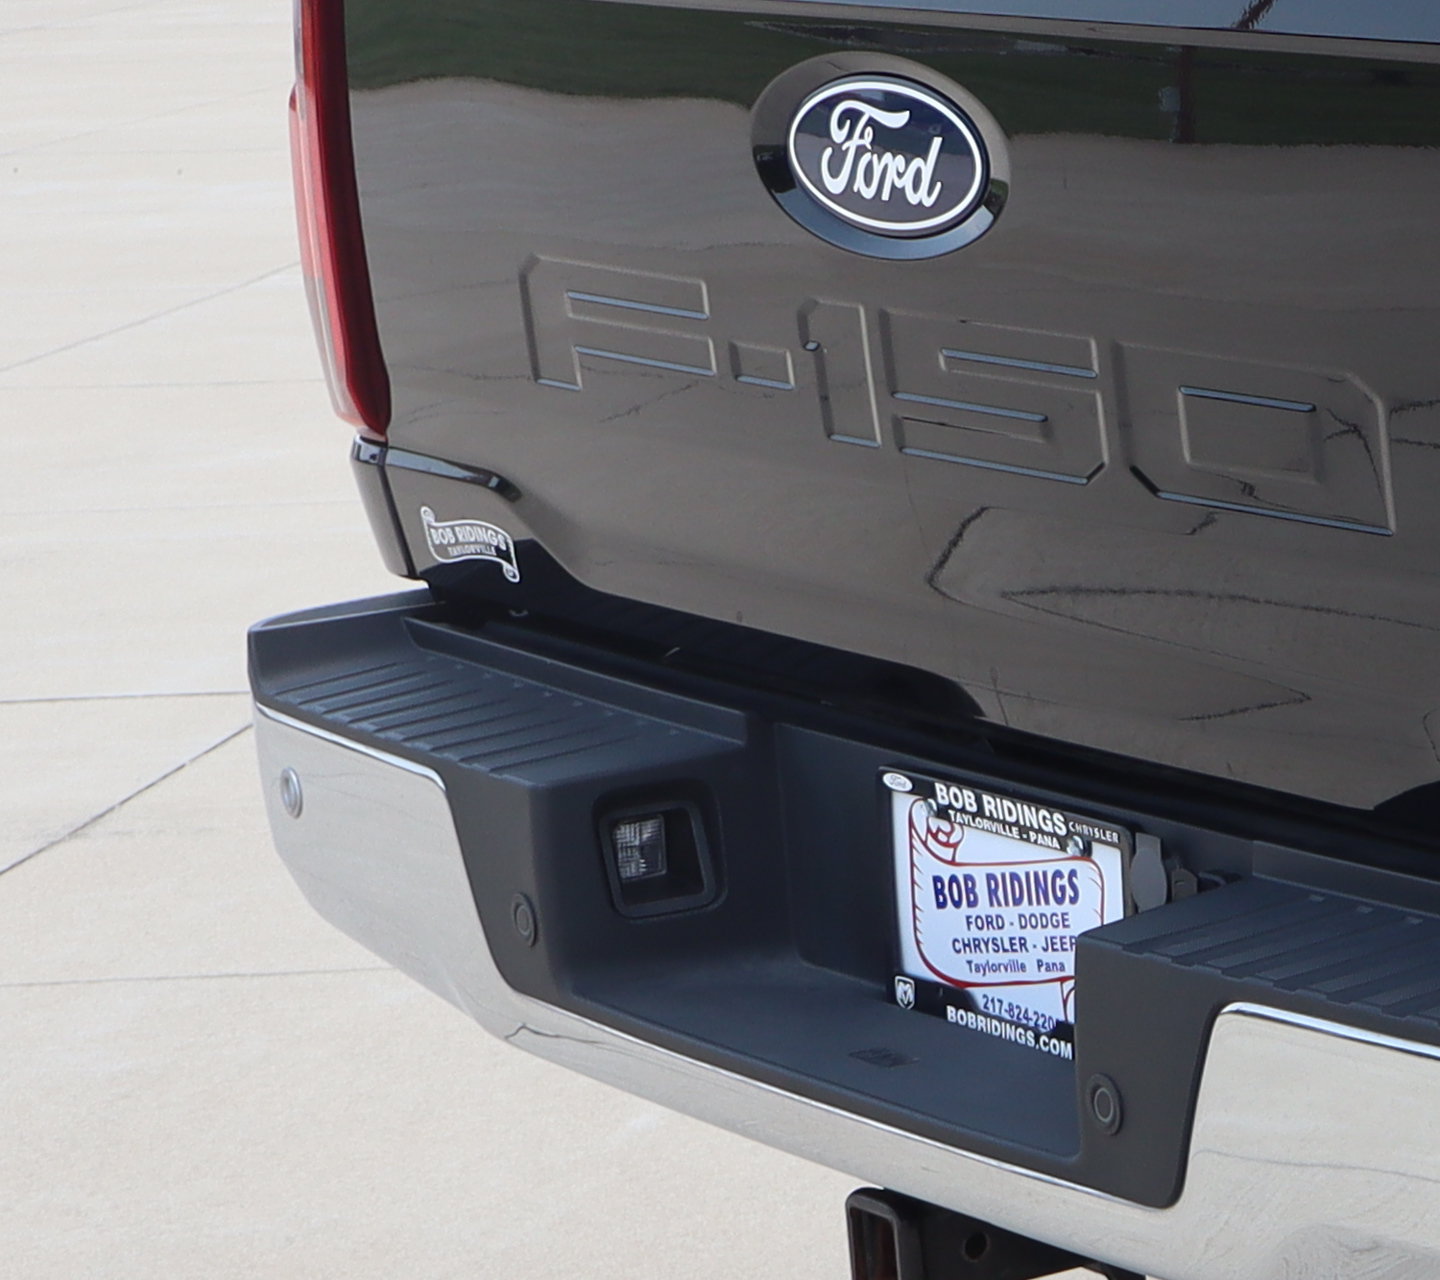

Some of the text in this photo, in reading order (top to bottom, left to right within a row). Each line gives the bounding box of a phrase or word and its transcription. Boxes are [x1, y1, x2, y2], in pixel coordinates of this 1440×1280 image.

[820, 98, 942, 208] Ford
[518, 253, 1394, 538] F-150
[430, 525, 507, 551] BOB RIDINGS
[934, 781, 979, 814] BOB
[981, 793, 1068, 837] RIDINGS
[948, 809, 1021, 840] TAYLORVILLE
[1029, 830, 1061, 850] PANA
[931, 867, 1080, 910] BOB RIDINGS
[965, 913, 1005, 932] FORD
[1018, 911, 1071, 930] DODGE
[951, 935, 1029, 955] CHRYSLER
[966, 957, 1066, 977] Taylorville Pana
[946, 1004, 1073, 1061] BOBRIDINGS.COM
[982, 993, 1059, 1032] 217-824-220
